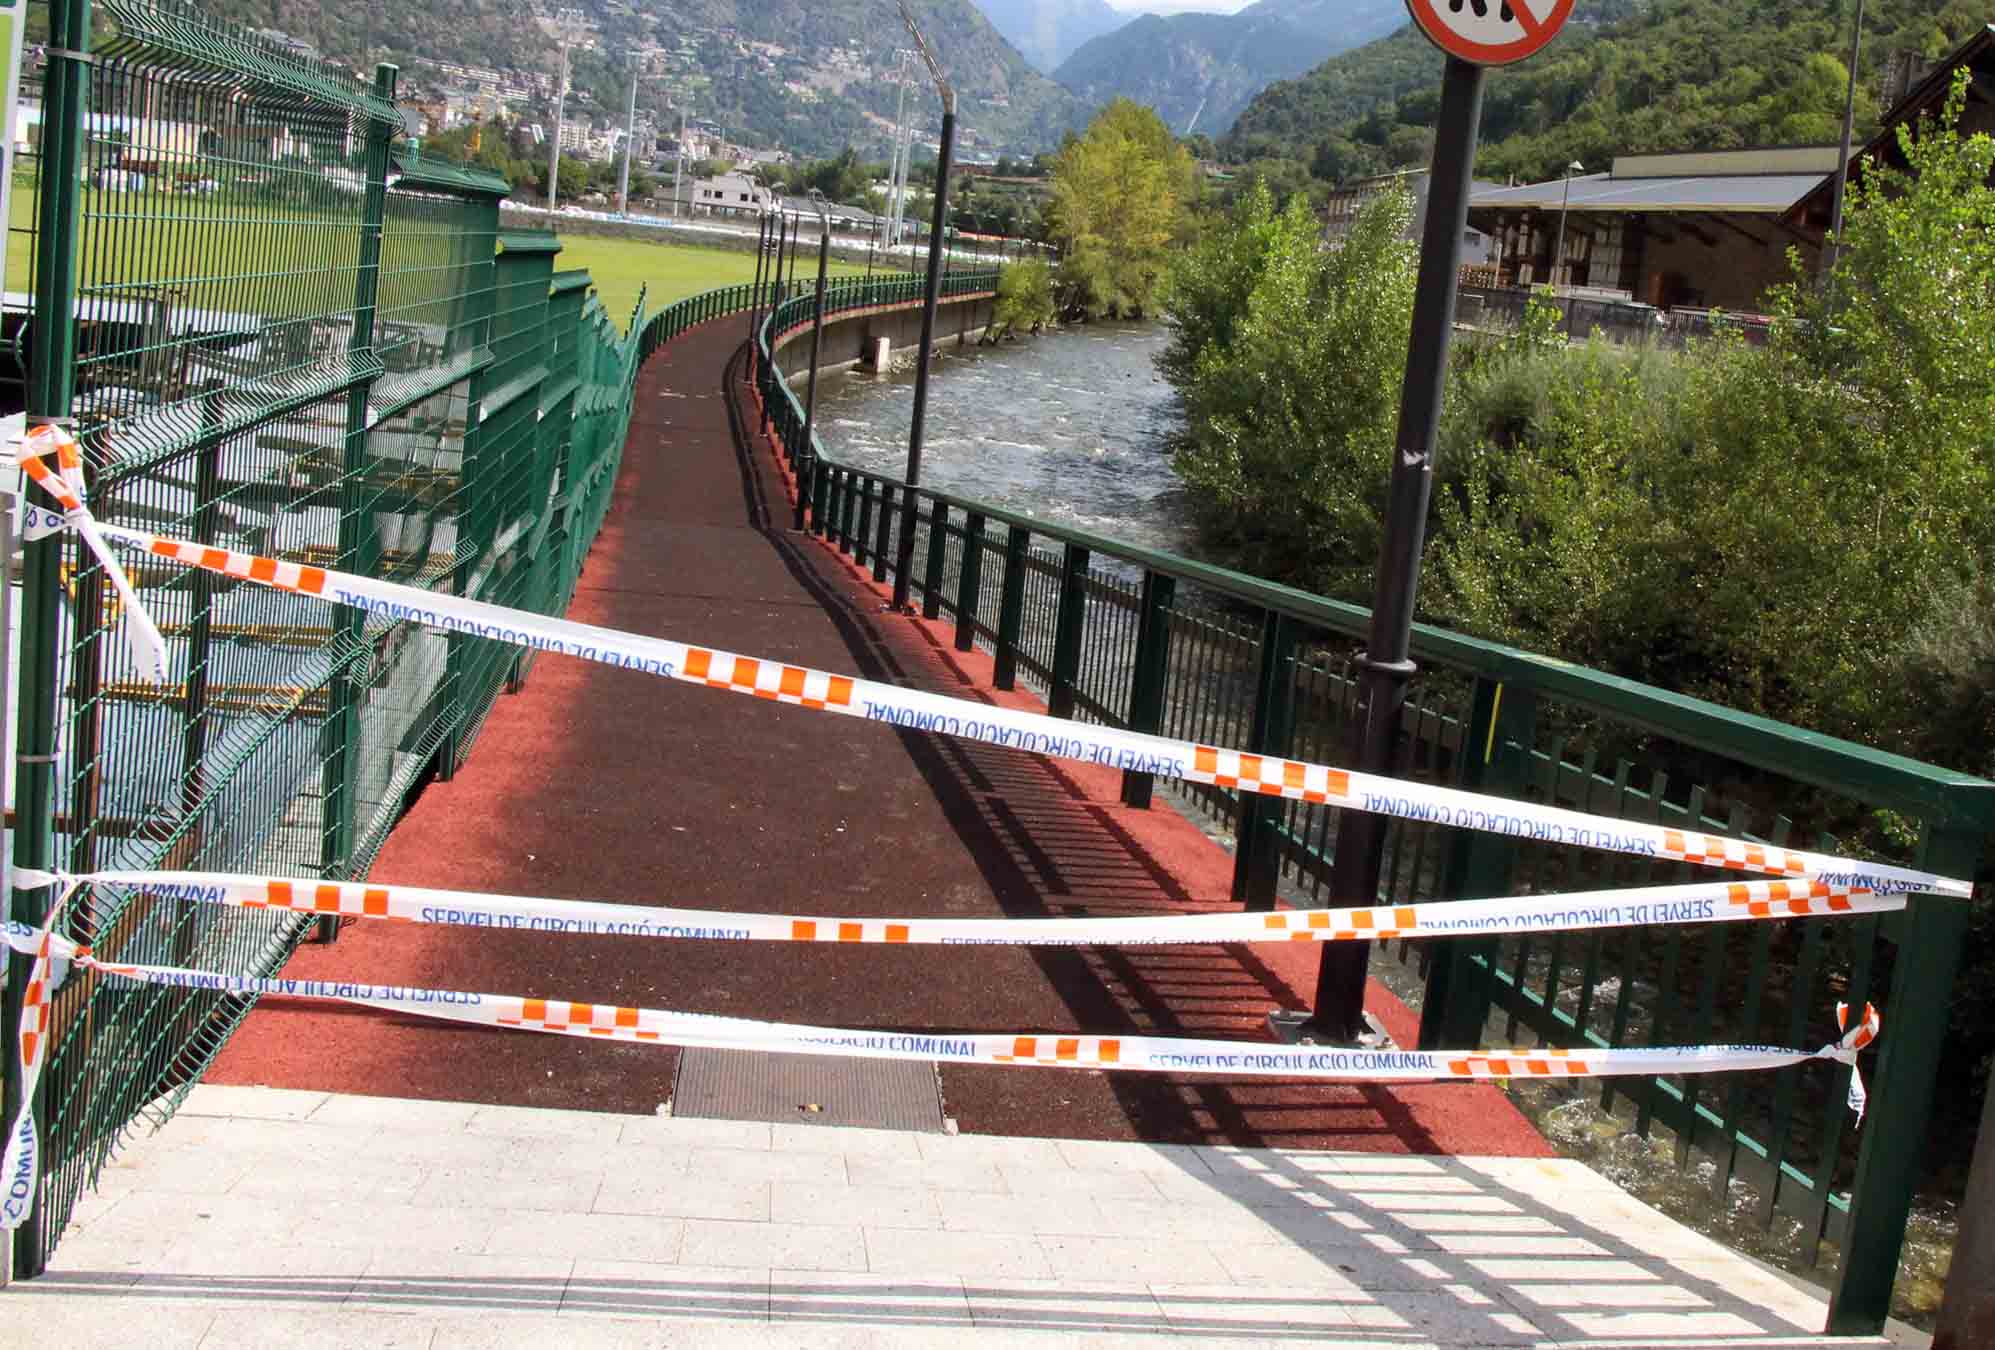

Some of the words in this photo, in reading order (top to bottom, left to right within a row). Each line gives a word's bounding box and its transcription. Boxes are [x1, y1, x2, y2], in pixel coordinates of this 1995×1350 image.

[864, 701, 959, 735] COMUNAL
[1088, 744, 1112, 767] DE
[1118, 749, 1184, 778] SERVEI
[1360, 793, 1450, 824] COMUNAL
[1569, 827, 1590, 845] DE
[1595, 832, 1657, 855] SERVEI
[422, 907, 492, 927] SERVEI
[499, 915, 524, 929] DE
[1626, 906, 1648, 924] DE
[1654, 899, 1714, 921] SERVEI
[380, 986, 404, 1000] DE
[1353, 1053, 1436, 1070] COMUNAL
